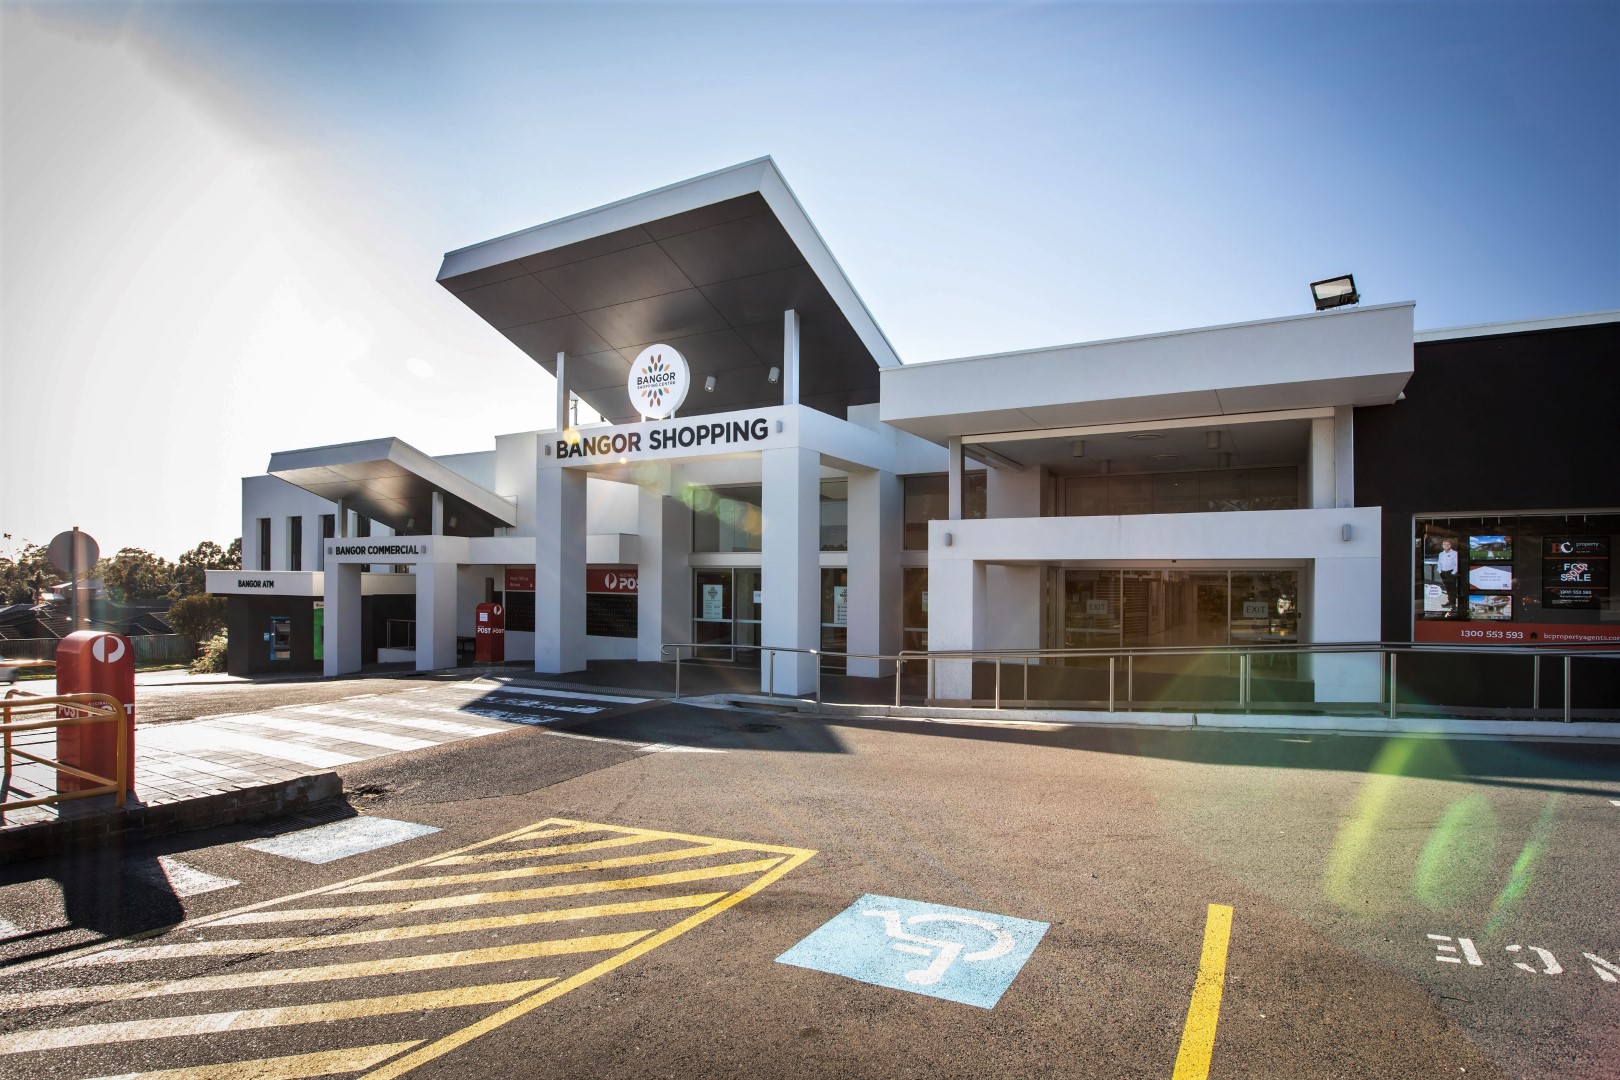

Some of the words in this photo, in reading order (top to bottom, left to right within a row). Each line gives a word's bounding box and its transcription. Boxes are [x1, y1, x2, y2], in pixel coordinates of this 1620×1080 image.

[637, 372, 676, 386] BANGOR
[556, 432, 642, 459] BANGOR
[649, 418, 769, 450] SHOPPING
[335, 546, 366, 555] BANGOR
[367, 545, 419, 555] COMMERCIAL
[1563, 563, 1588, 571] FOR
[1560, 573, 1592, 582] SALE
[237, 579, 262, 588] BANGOR
[262, 580, 274, 588] ATM
[619, 578, 638, 590] PO
[1089, 603, 1106, 611] EXIT
[1246, 605, 1266, 614] EXIT
[1460, 629, 1483, 637] 1300
[1486, 630, 1504, 638] 553
[1505, 631, 1524, 639] 593
